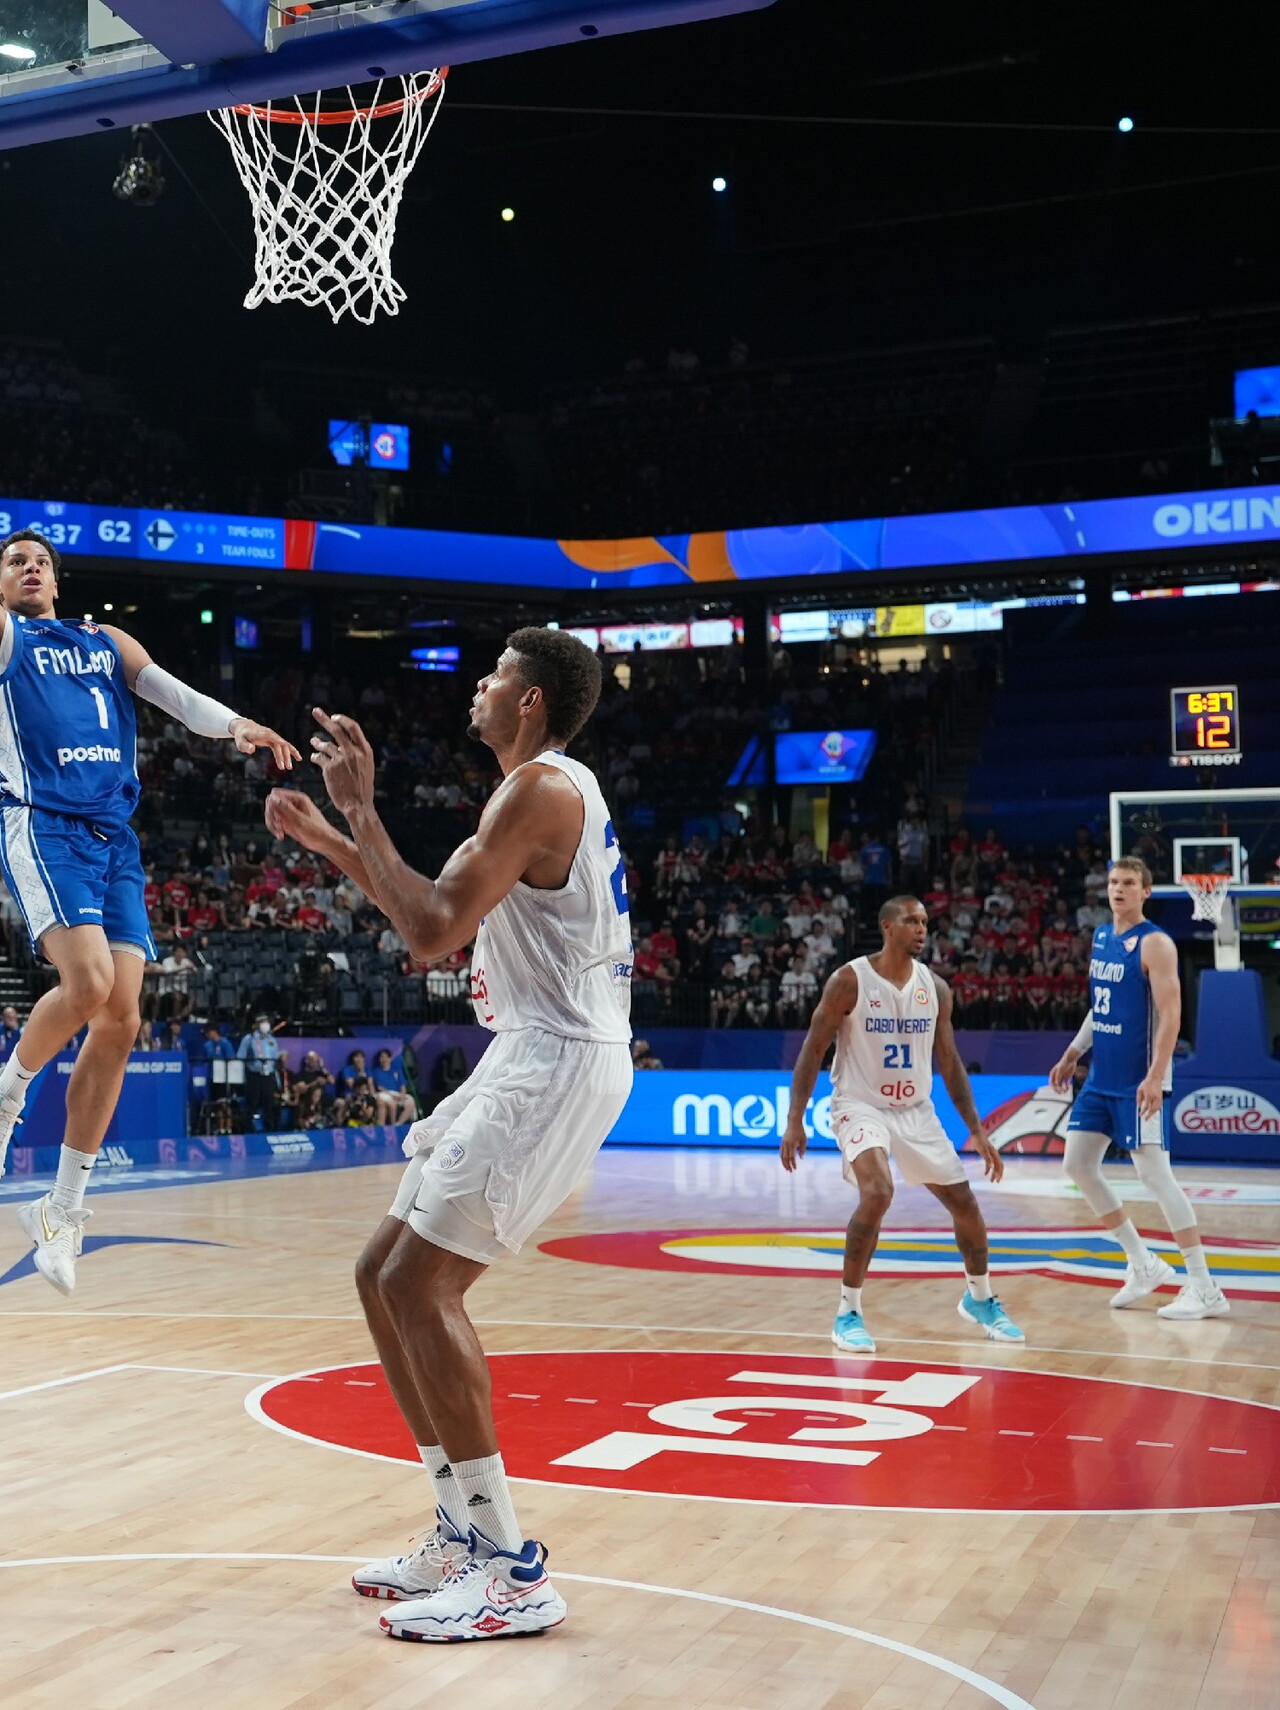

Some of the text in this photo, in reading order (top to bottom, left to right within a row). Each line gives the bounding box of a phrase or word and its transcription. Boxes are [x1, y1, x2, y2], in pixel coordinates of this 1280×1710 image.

[1153, 496, 1280, 537] OKIN
[29, 521, 81, 545] 6:37
[98, 520, 131, 543] 62
[196, 543, 204, 555] 3
[90, 686, 109, 730] 1
[1188, 692, 1233, 714] 6:37
[1197, 715, 1230, 748] 12
[1094, 986, 1111, 1016] 23
[865, 1017, 931, 1034] CABO VERDE
[883, 1044, 913, 1069] 21
[1194, 1092, 1256, 1111] 百岁山
[548, 1370, 982, 1470] TCL
